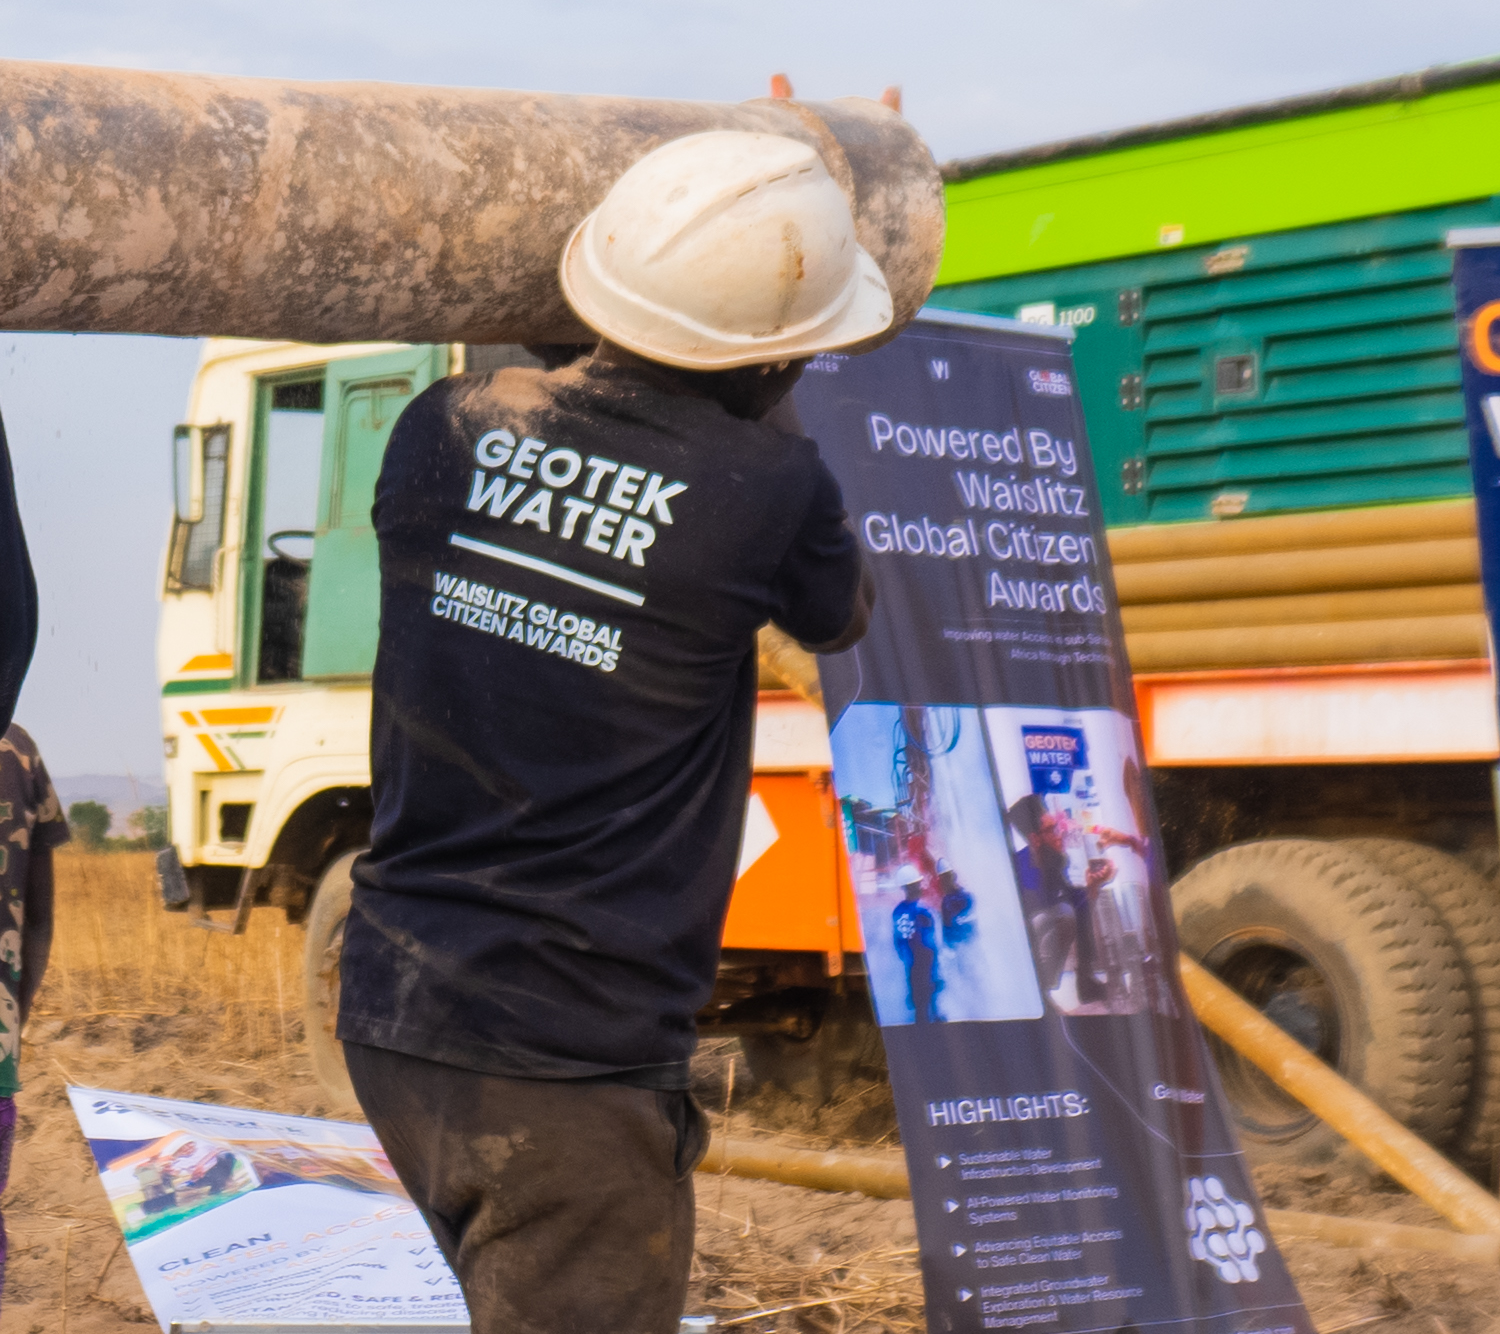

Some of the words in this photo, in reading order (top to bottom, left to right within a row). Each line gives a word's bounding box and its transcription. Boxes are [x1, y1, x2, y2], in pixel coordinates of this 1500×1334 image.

[1032, 381, 1073, 396] CITIZEN
[870, 414, 1022, 464] Powered
[1028, 430, 1077, 475] By
[474, 429, 688, 525] GEOTEK
[956, 471, 1089, 517] Waislitz
[465, 469, 657, 568] WATER
[863, 512, 979, 558] Global
[986, 521, 1097, 565] Citizen
[987, 571, 1107, 616] Awards
[433, 572, 528, 621] WAISLITZ
[528, 603, 624, 653] GLOBAL
[430, 594, 507, 640] CITIZEN
[506, 619, 620, 673] AWARDS
[1024, 734, 1079, 752] GEOTEK
[1028, 751, 1073, 766] WATER
[929, 1091, 1091, 1127] HIGHLIGHTS:
[958, 1149, 1021, 1166] Sustainable
[1031, 1158, 1102, 1176] Development
[968, 1209, 1018, 1227] Systems
[157, 1232, 273, 1272] CLEAN
[161, 1241, 290, 1281] WATER
[301, 1203, 419, 1244] ACCES
[974, 1238, 1032, 1254] Advancing
[1081, 1229, 1124, 1244] Access
[173, 1256, 290, 1291] POWERED
[975, 1257, 989, 1269] to
[990, 1255, 1018, 1268] Safe
[352, 1294, 402, 1303] SAFE
[980, 1281, 1039, 1299] Integrated
[982, 1296, 1046, 1315] Exploration
[1047, 1294, 1059, 1307] &
[1092, 1286, 1144, 1302] Resource
[983, 1310, 1060, 1329] Management
